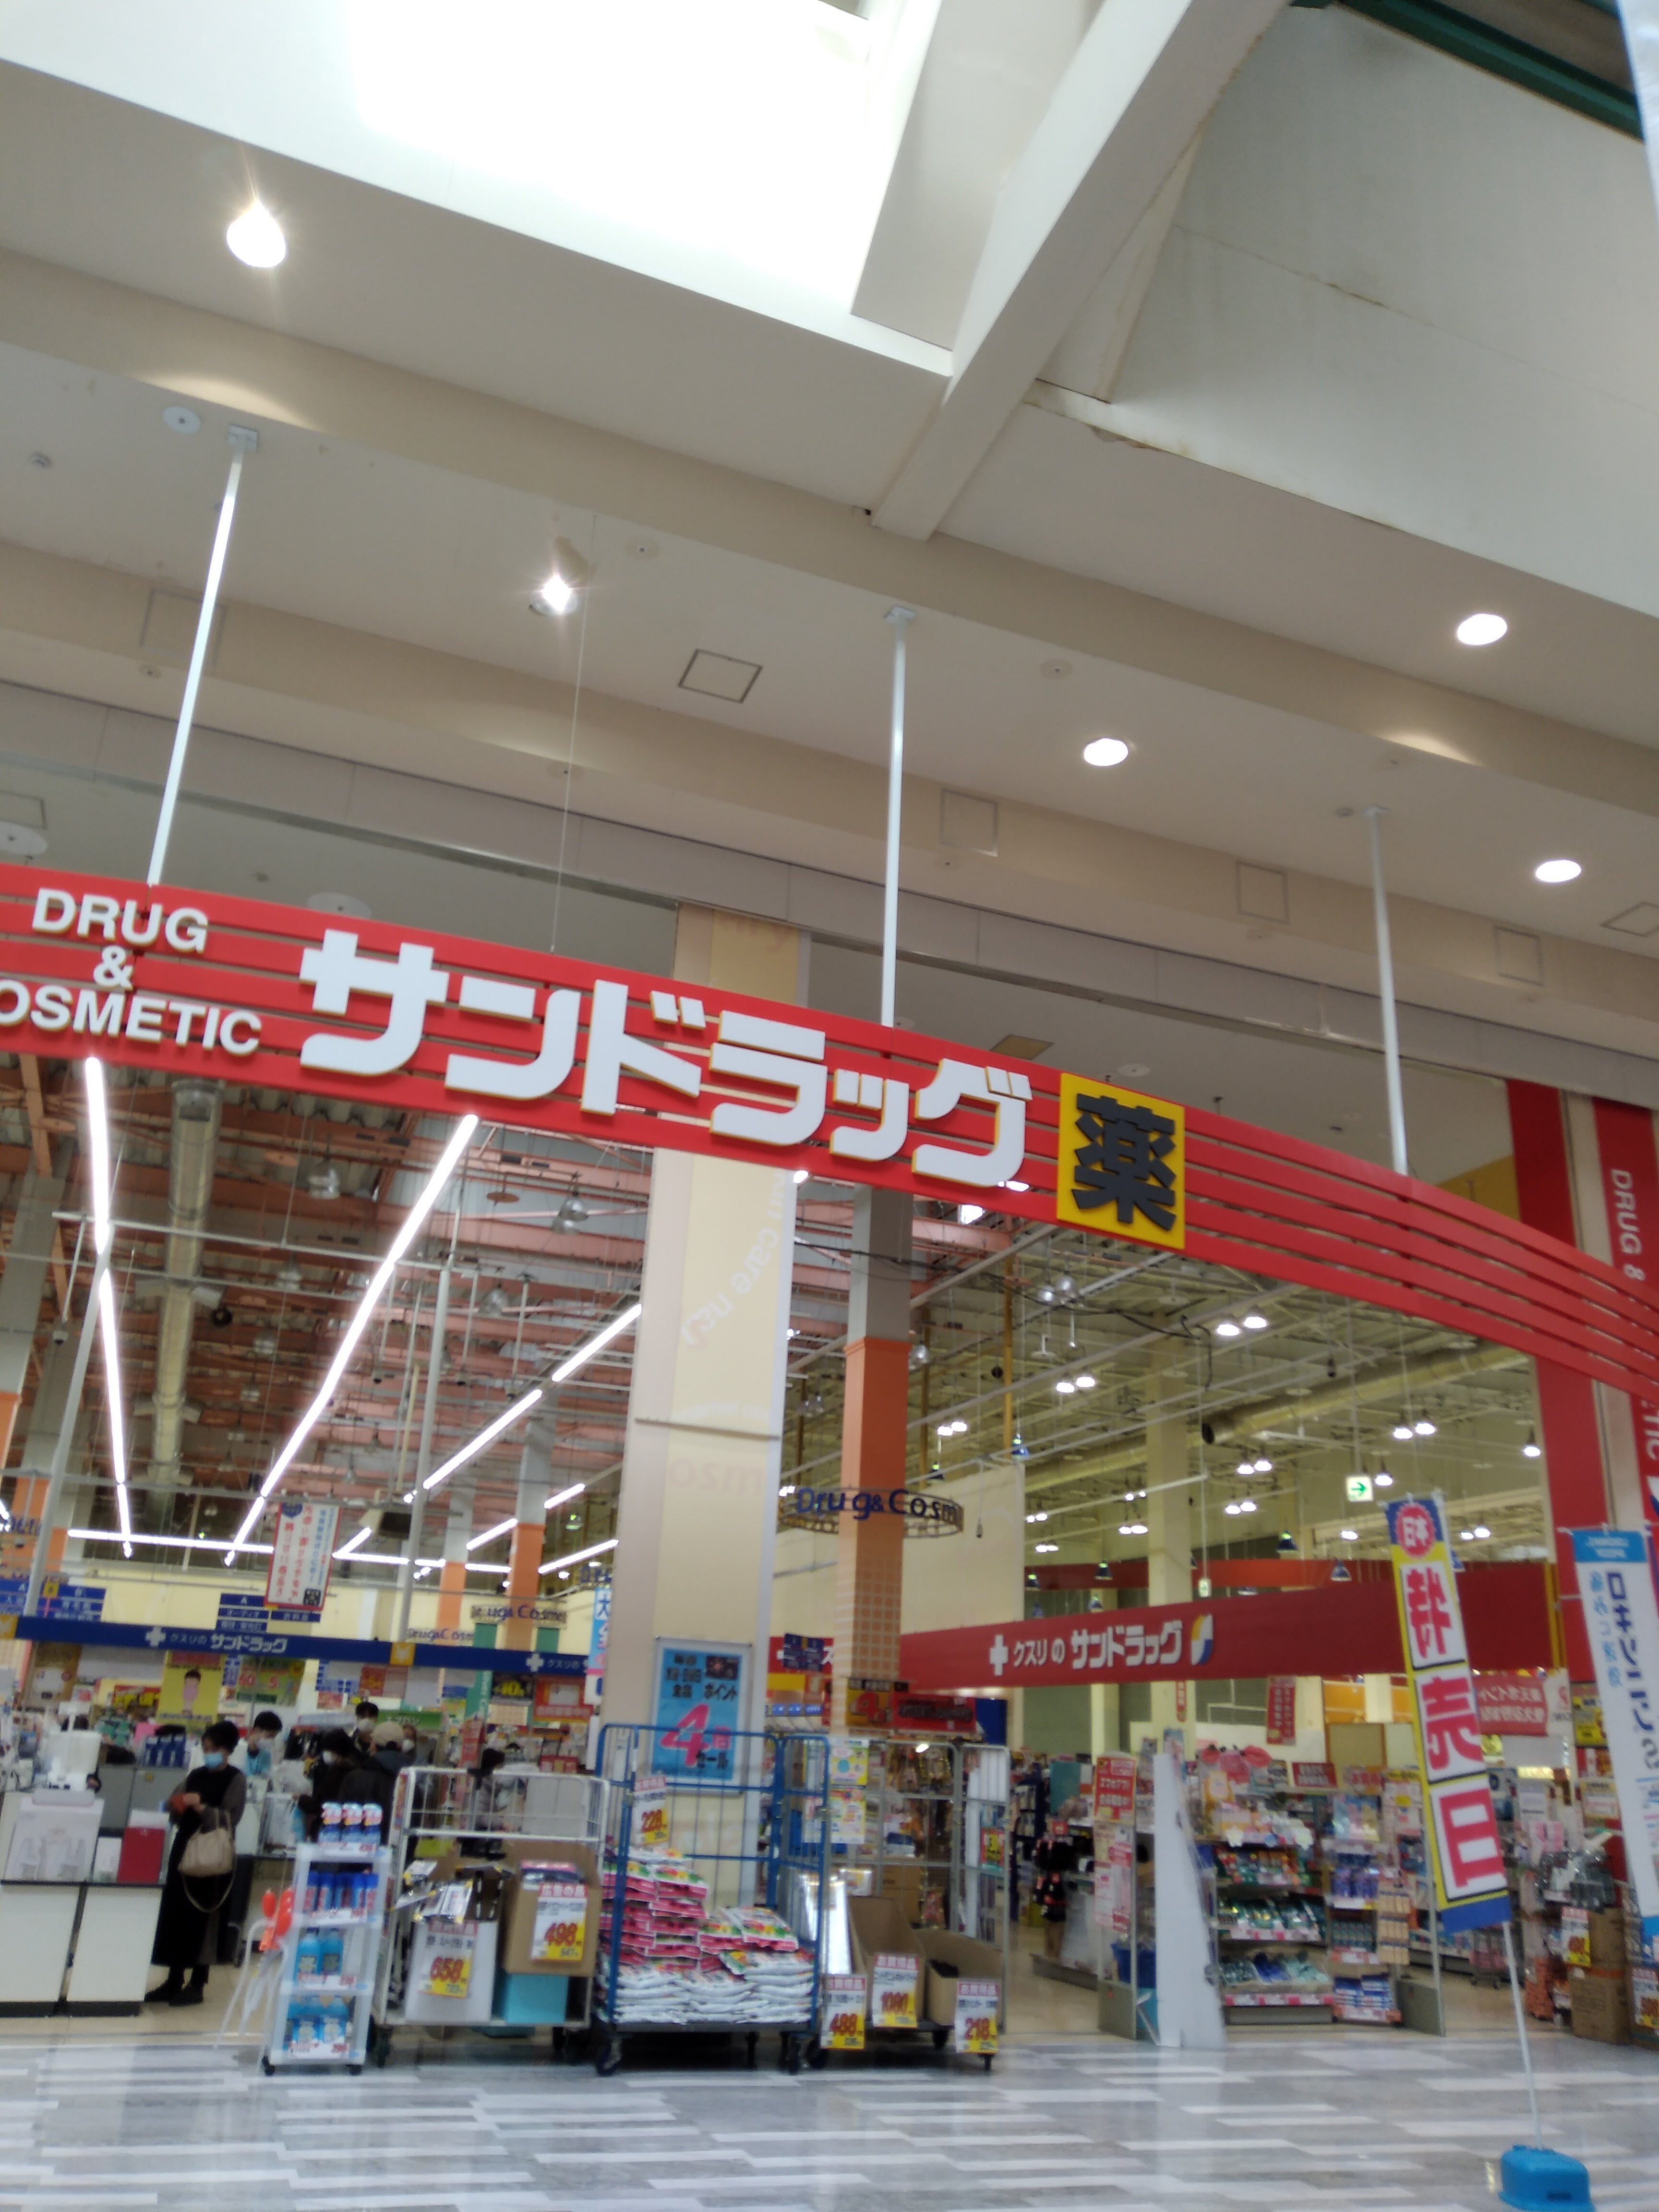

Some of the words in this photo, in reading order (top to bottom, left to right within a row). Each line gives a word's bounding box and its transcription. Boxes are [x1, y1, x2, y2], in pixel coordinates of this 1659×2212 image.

[32, 888, 208, 953] DRUG
[93, 945, 134, 991] &
[299, 928, 1033, 1187] サンドラッグ
[1071, 1094, 1177, 1231] 薬
[1611, 1168, 1642, 1255] DRUG
[210, 1632, 288, 1654] サンドラッグ
[1013, 1638, 1065, 1668] クスリの
[1070, 1620, 1183, 1670] サンドラッグ
